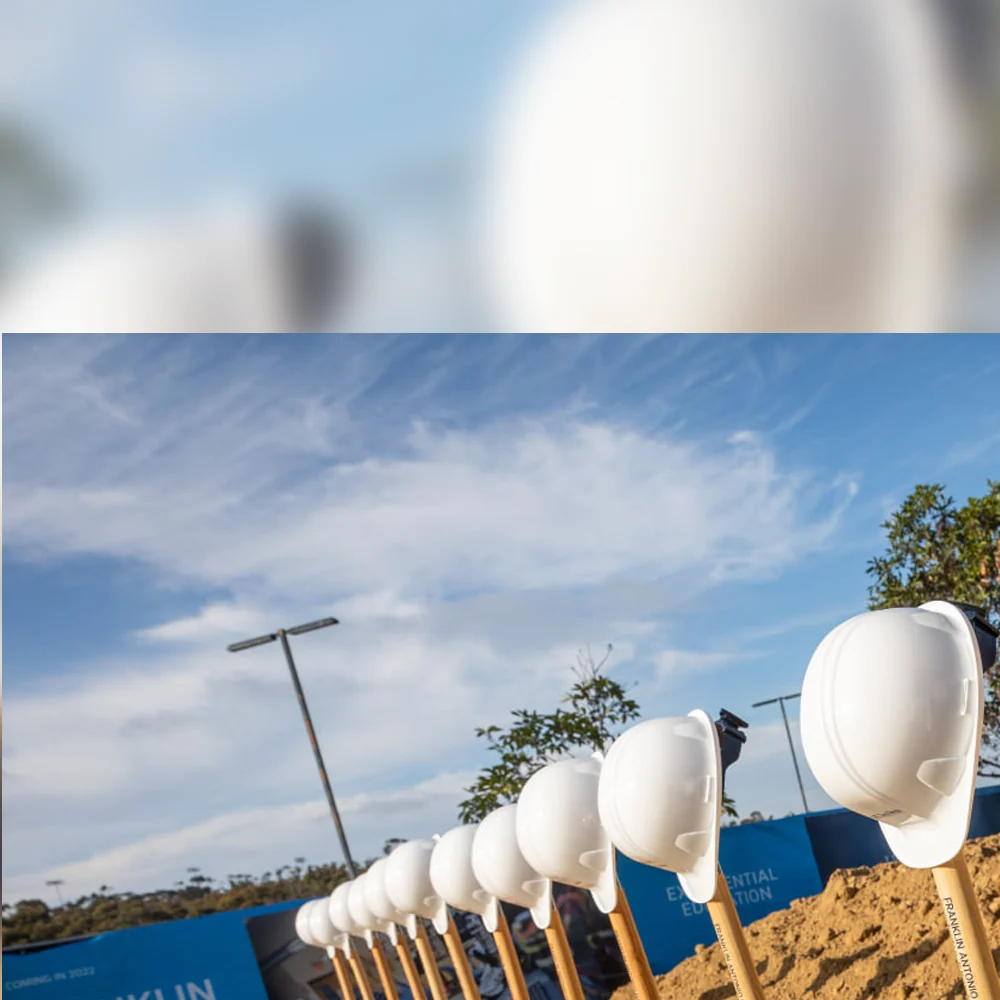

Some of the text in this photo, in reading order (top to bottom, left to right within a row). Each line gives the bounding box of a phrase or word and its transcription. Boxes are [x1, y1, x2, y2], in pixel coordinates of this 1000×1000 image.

[665, 867, 779, 902] EXENTIAL
[681, 885, 774, 917] EDTION
[943, 897, 964, 949] FRANKLIN
[959, 952, 978, 999] ANTONIO
